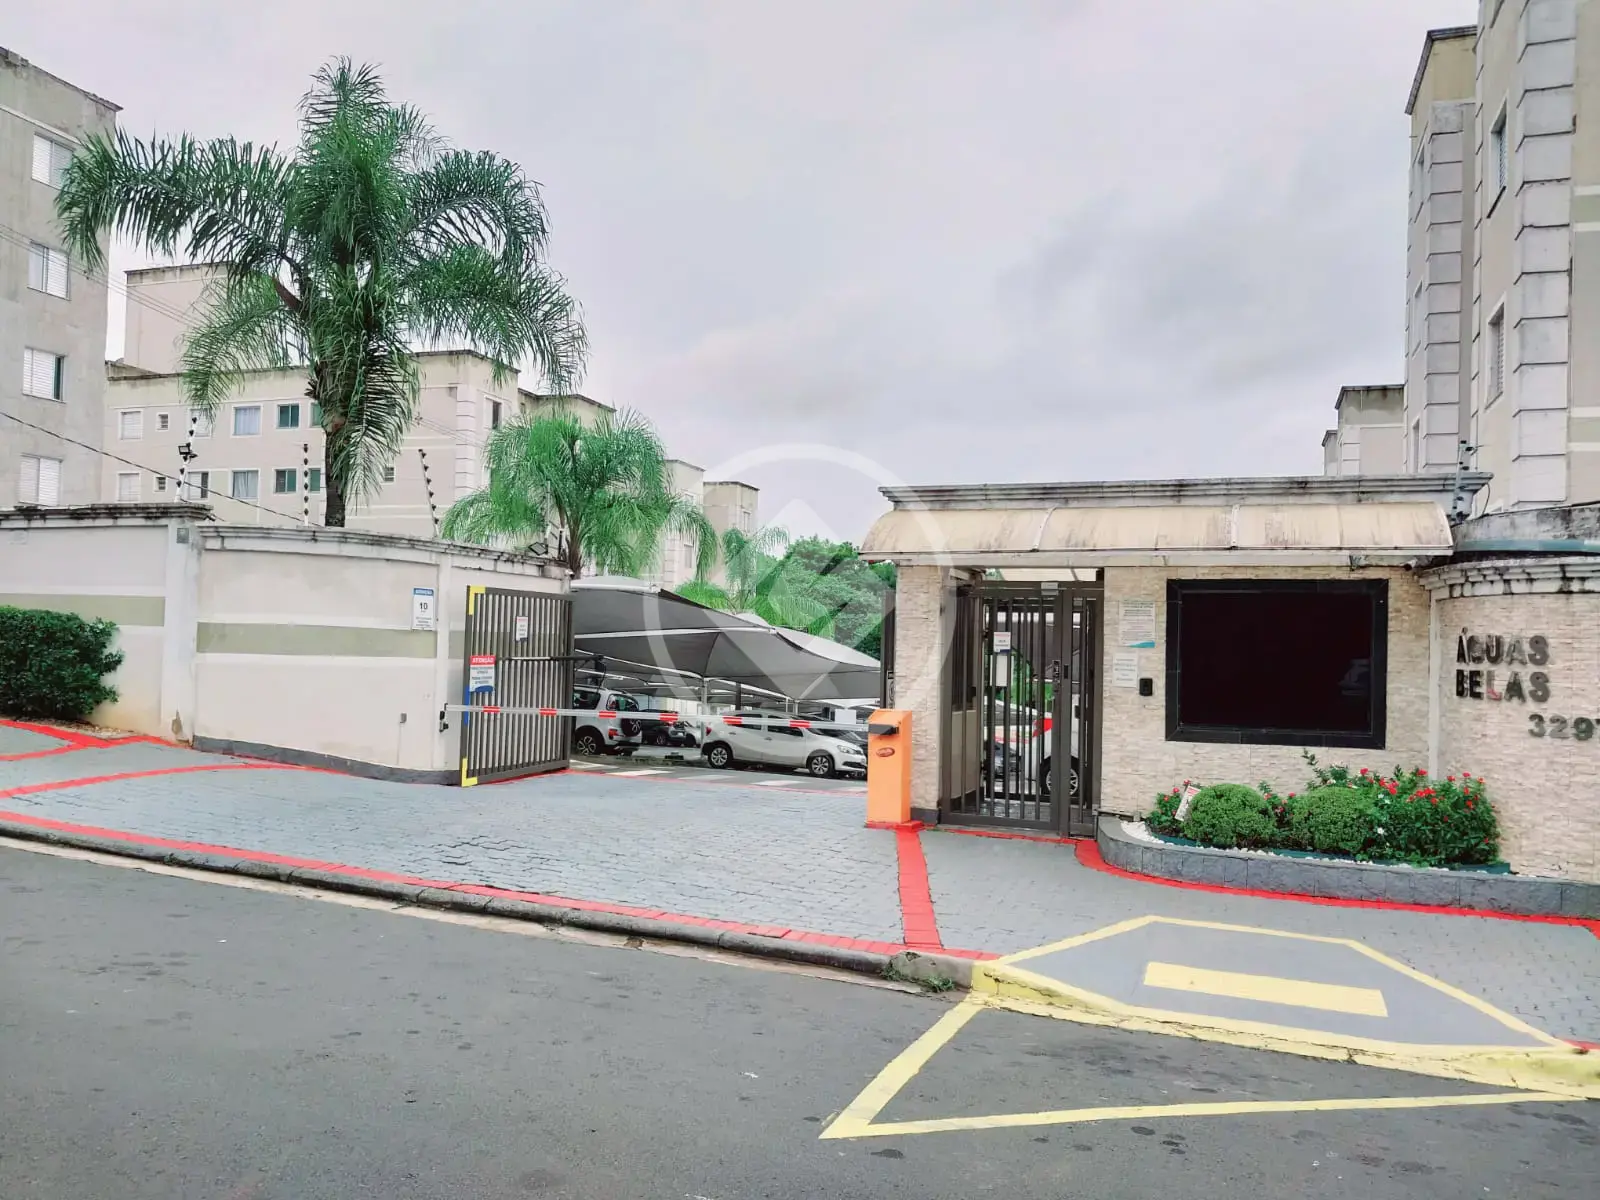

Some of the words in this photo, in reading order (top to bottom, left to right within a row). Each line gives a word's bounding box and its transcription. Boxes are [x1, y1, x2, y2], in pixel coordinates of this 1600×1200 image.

[419, 602, 428, 610] 10
[1456, 627, 1550, 666] ÁGUAS
[1456, 669, 1551, 703] BELAS
